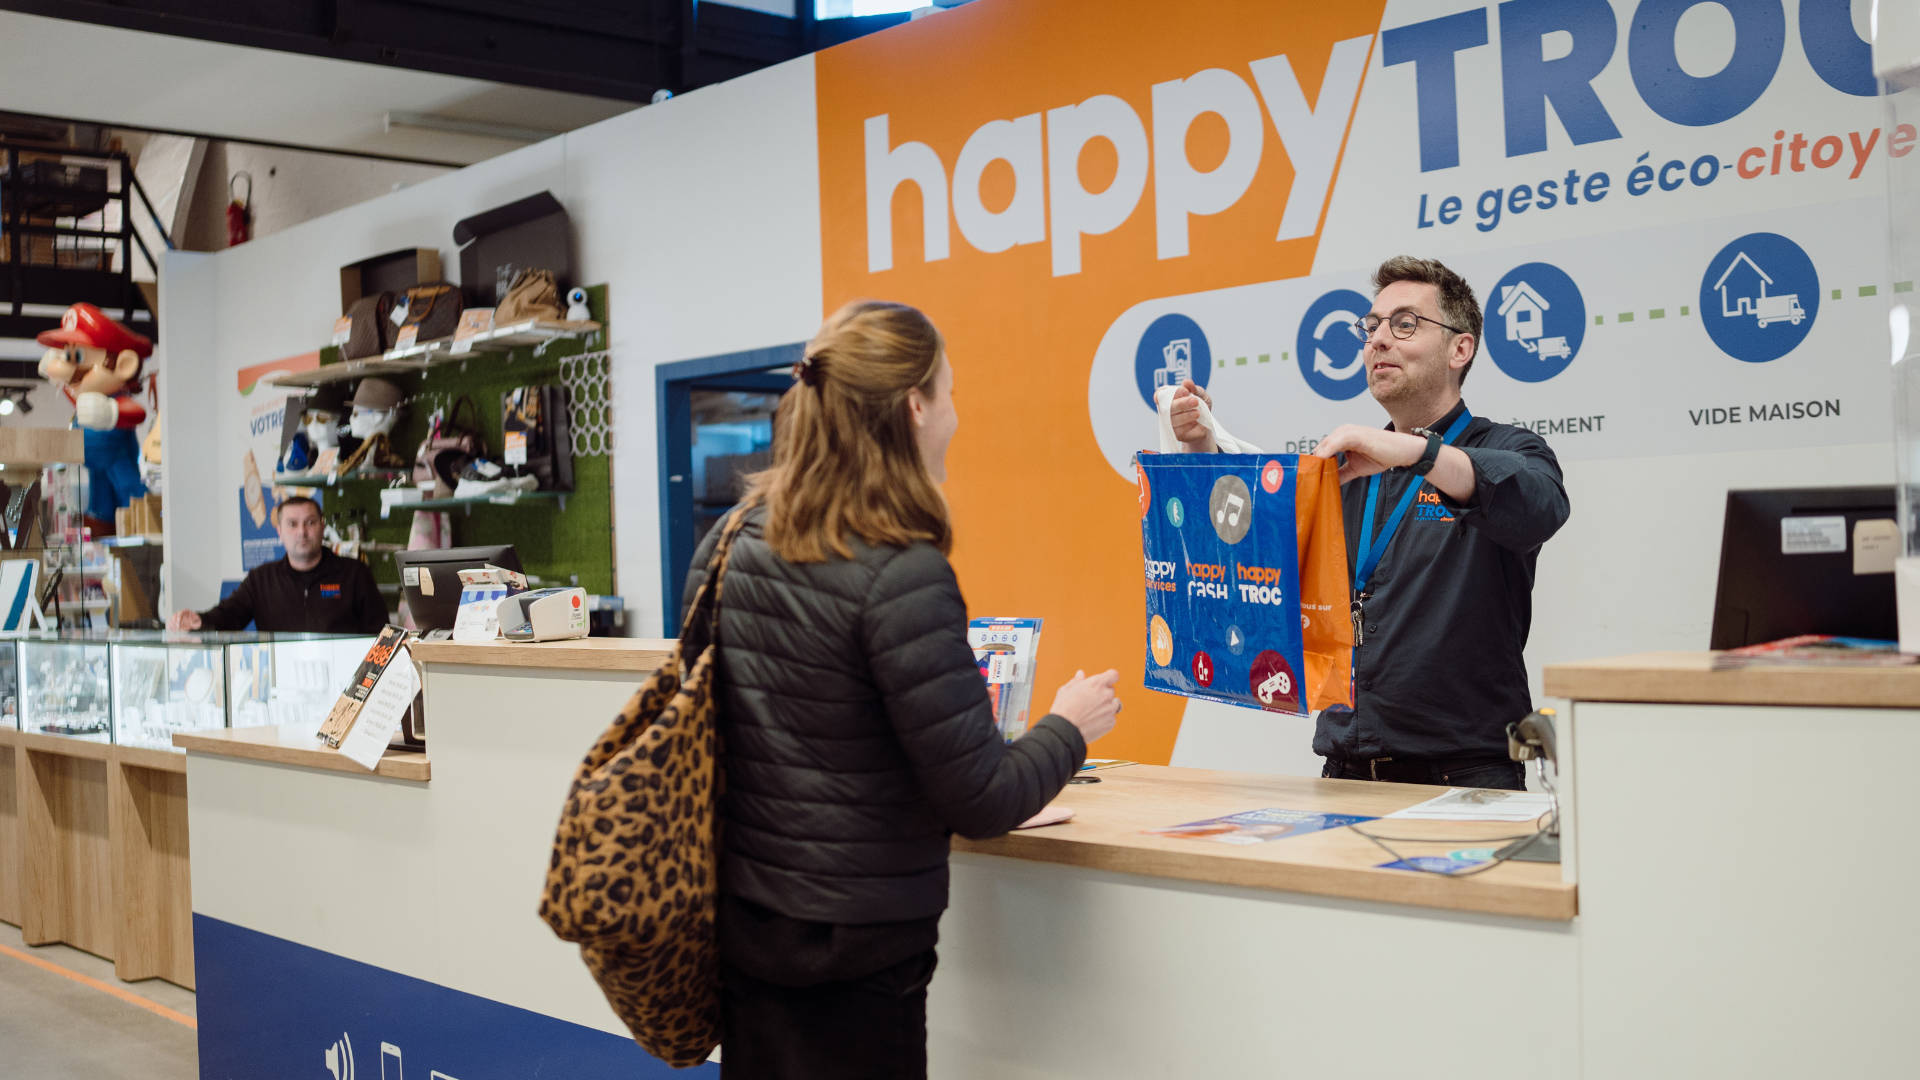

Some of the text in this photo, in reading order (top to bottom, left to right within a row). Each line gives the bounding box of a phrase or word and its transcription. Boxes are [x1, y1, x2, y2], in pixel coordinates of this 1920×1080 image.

[864, 34, 1374, 277] happy
[1417, 193, 1462, 229] Le
[1476, 169, 1610, 232] geste
[1688, 399, 1841, 426] VIDE MAISON
[1418, 490, 1441, 505] hap
[1186, 559, 1226, 583] happy
[1237, 562, 1281, 586] happy
[1238, 584, 1282, 605] TROC
[469, 603, 490, 612] Google
